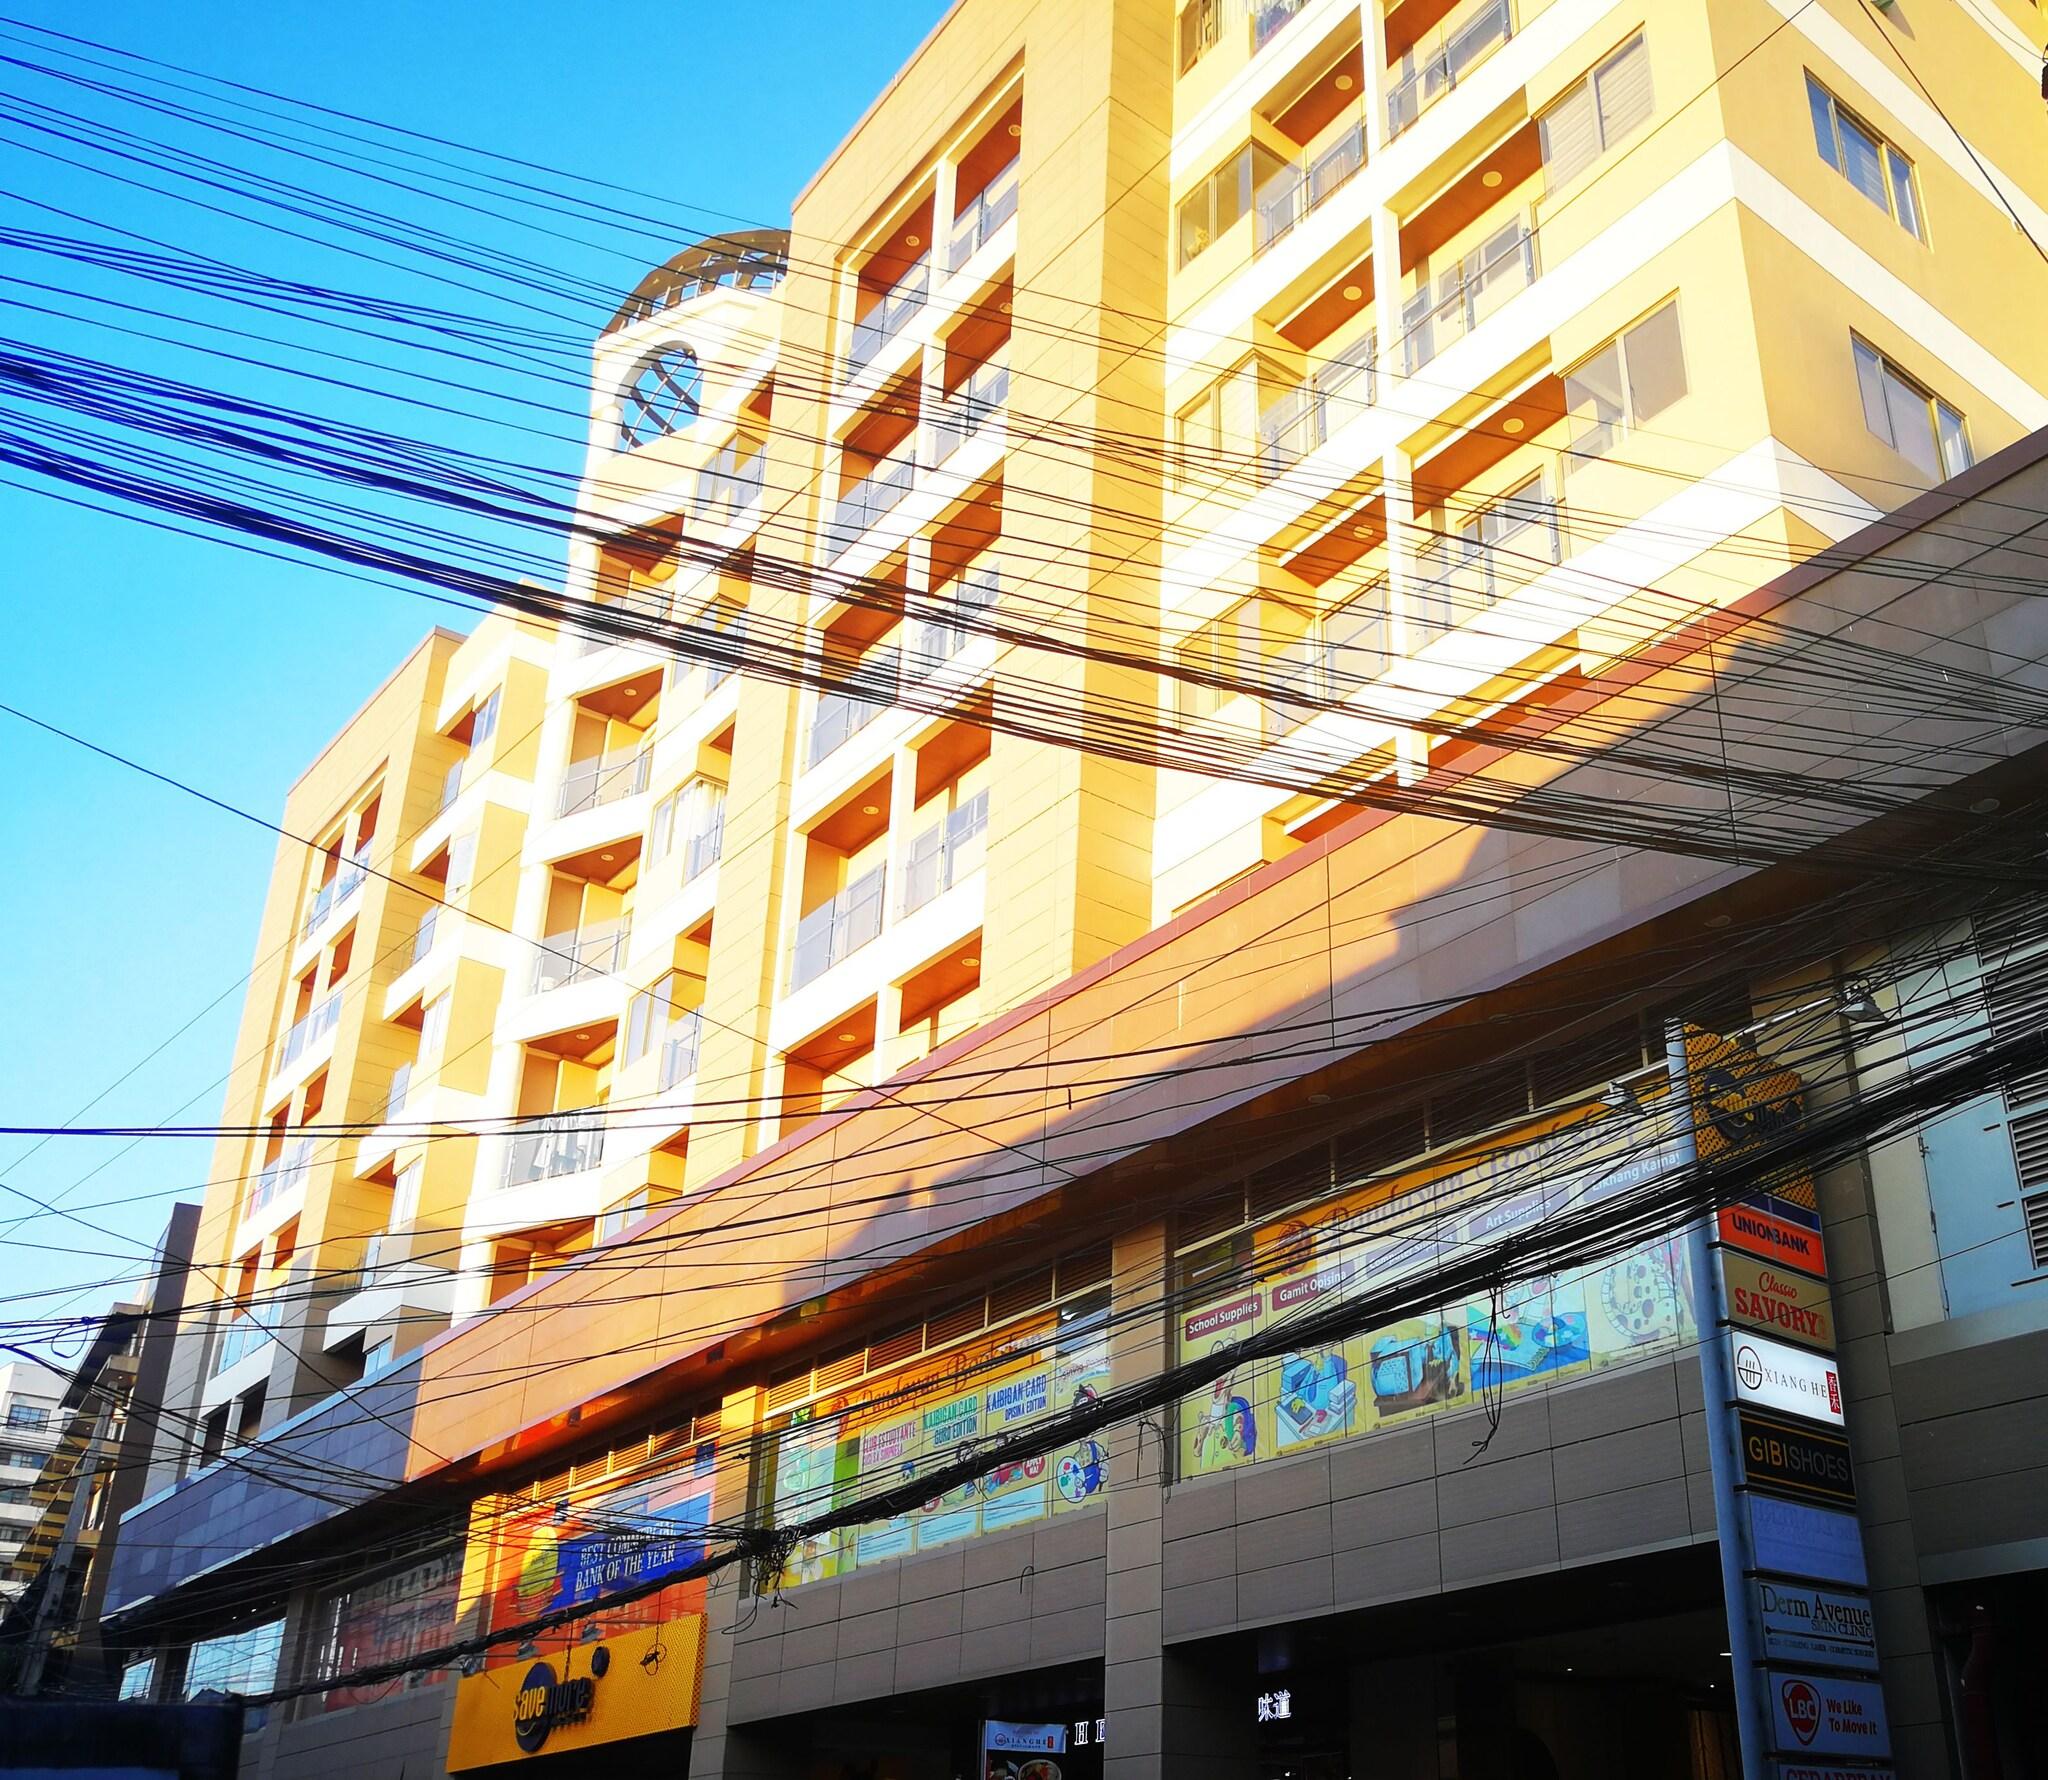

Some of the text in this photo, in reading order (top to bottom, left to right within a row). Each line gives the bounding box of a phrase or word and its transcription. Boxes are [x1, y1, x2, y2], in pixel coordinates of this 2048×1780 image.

[1486, 1215, 1503, 1229] Art
[1732, 1213, 1810, 1256] UNIONBANK
[1279, 1271, 1347, 1302] Gamit Opisina
[1758, 1271, 1798, 1299] Classic
[1188, 1301, 1258, 1334] School Supplies
[1734, 1287, 1819, 1338] SAVORY
[1025, 1374, 1047, 1397] CARD
[1765, 1367, 1828, 1398] XIANG HE
[1026, 1396, 1047, 1414] EDITION
[575, 1544, 676, 1592] BANK OF THE YEAR
[1760, 1584, 1872, 1626] Derm Avenue
[1838, 1623, 1873, 1638] CLINIC
[1258, 1689, 1291, 1722] 味道
[1789, 1697, 1816, 1720] LBC
[1826, 1699, 1863, 1716] We Like
[1829, 1717, 1877, 1735] To Move It
